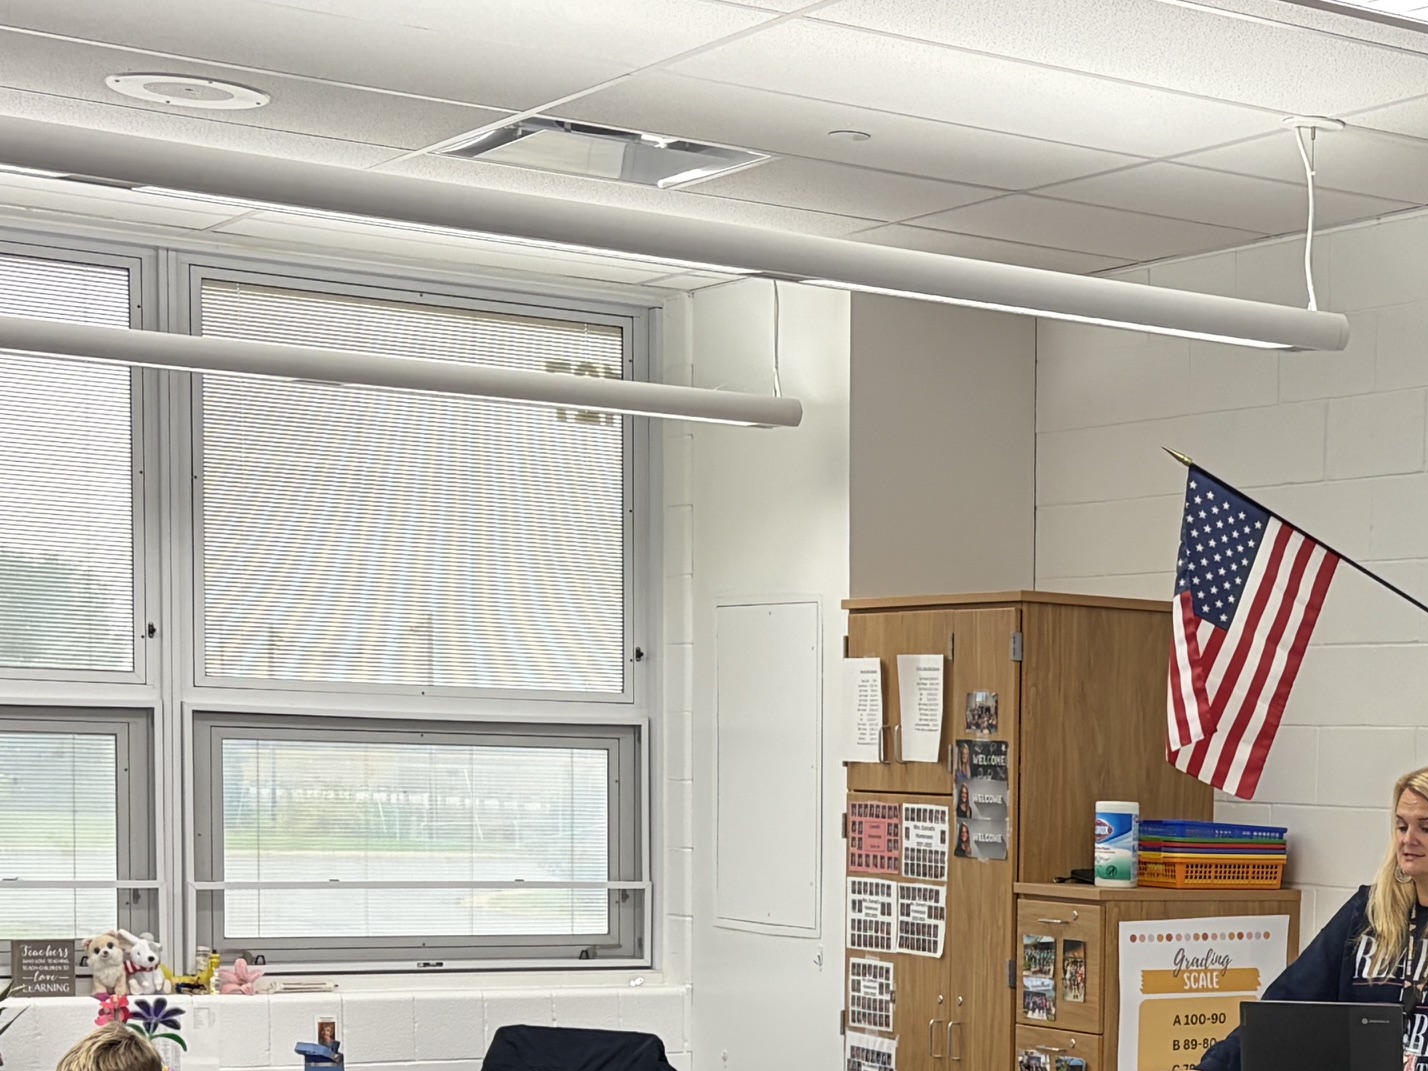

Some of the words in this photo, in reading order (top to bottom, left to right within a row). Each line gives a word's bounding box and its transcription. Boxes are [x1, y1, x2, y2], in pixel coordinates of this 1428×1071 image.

[972, 754, 1006, 766] WELCOME
[972, 794, 1003, 804] WELCOME
[972, 834, 1003, 843] WELCOME
[20, 945, 68, 958] Teachers
[1173, 948, 1232, 977] Grading
[1184, 971, 1220, 990] SCALE
[1173, 1015, 1182, 1026] A
[1183, 1013, 1226, 1026] 100-90
[1172, 1040, 1180, 1051] B
